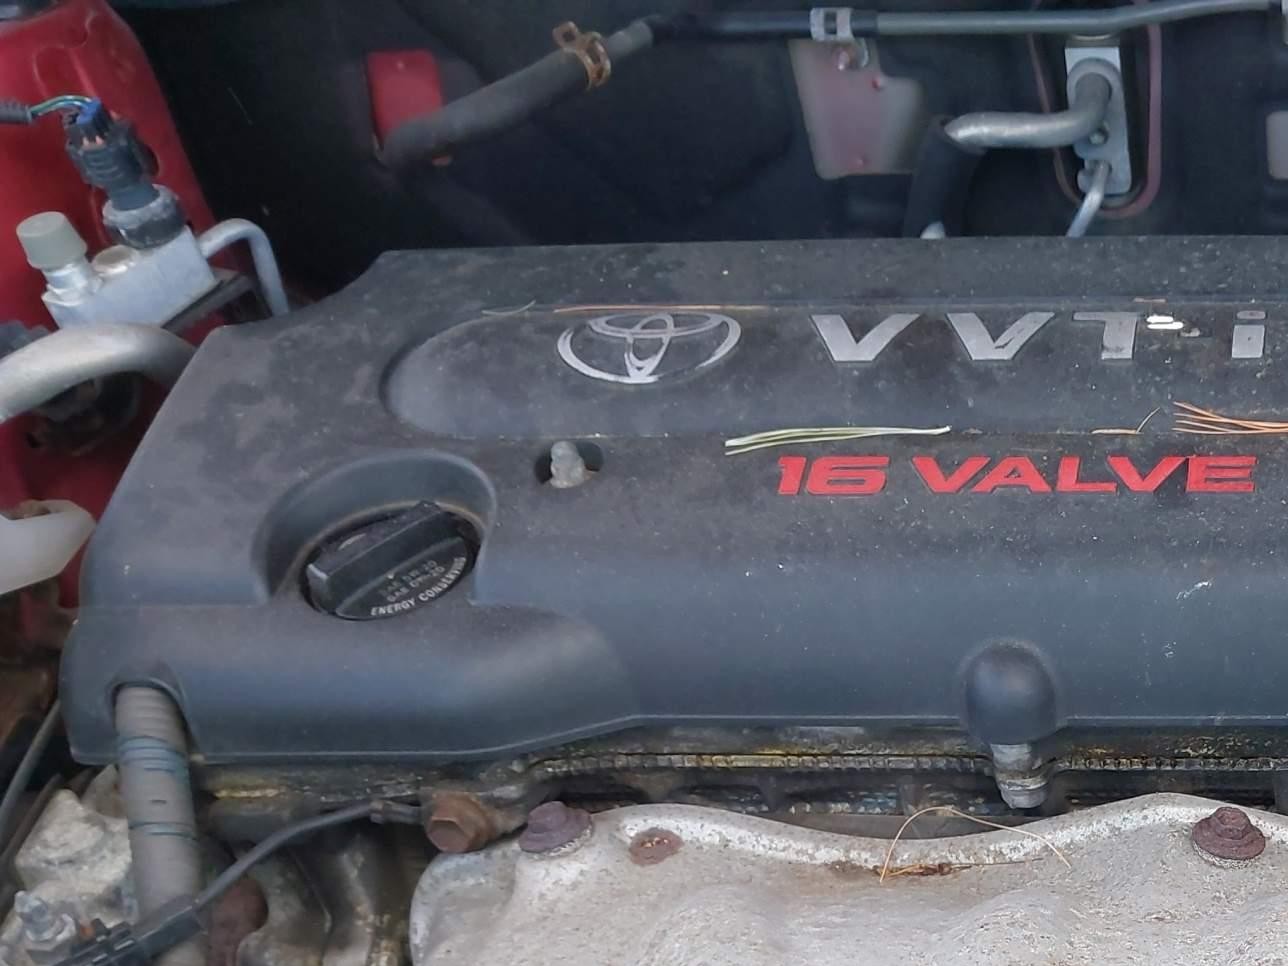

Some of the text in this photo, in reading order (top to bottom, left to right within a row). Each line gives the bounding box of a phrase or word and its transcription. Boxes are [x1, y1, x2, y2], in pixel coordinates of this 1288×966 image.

[777, 454, 1258, 496] 16 VALVE
[370, 597, 416, 616] ENERGY
